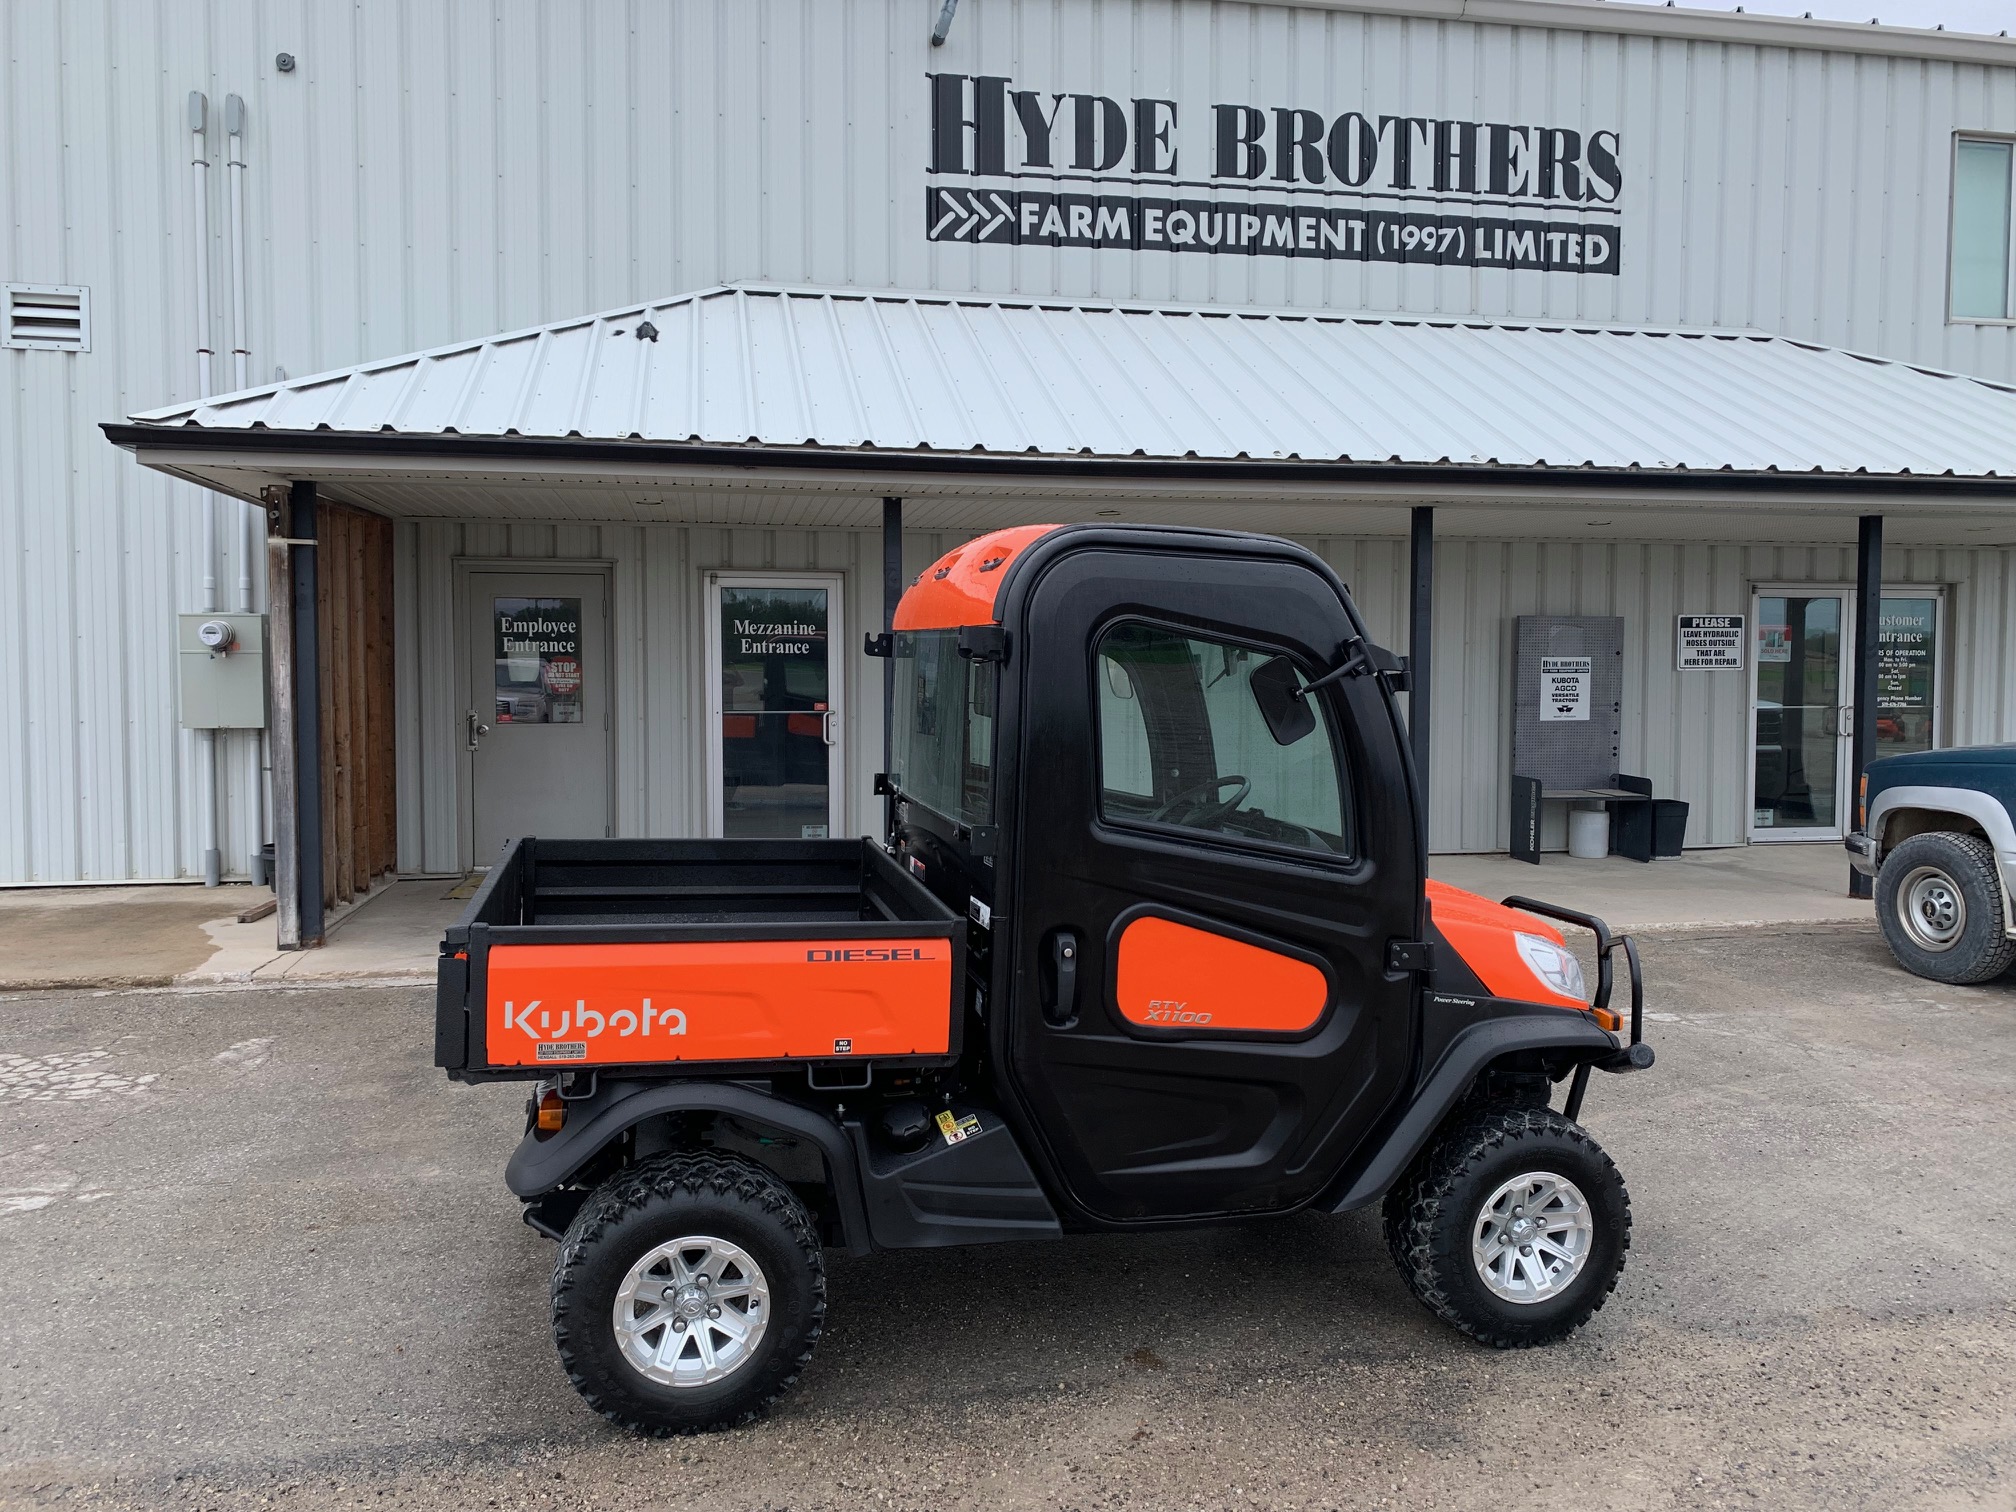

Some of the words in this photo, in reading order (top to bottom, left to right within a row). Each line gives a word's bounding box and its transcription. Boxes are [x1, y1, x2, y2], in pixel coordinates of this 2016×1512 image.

[925, 72, 1178, 176] HYDE
[1211, 104, 1622, 203] BROTHERS
[1021, 202, 1131, 240] FARM
[1145, 208, 1367, 251] EQUIPMENT
[1377, 221, 1466, 259] (1997)
[1475, 228, 1610, 265] LIMITED
[501, 617, 577, 637] Employee
[733, 619, 816, 635] Mezzanine
[1692, 618, 1731, 627] PLEASE
[1879, 615, 1925, 626] ustomer
[1683, 630, 1702, 638] LEAVE
[1703, 630, 1739, 638] HYDRAULIC
[1879, 631, 1923, 642] ntrance
[502, 637, 576, 652] Entrance
[740, 638, 810, 654] Entrance
[550, 661, 577, 673] STOP
[806, 948, 937, 963] DIESEL
[1148, 1000, 1188, 1010] RTV
[1452, 997, 1476, 1007] Steering
[503, 998, 687, 1040] Kubota
[1143, 1009, 1213, 1024] X1100
